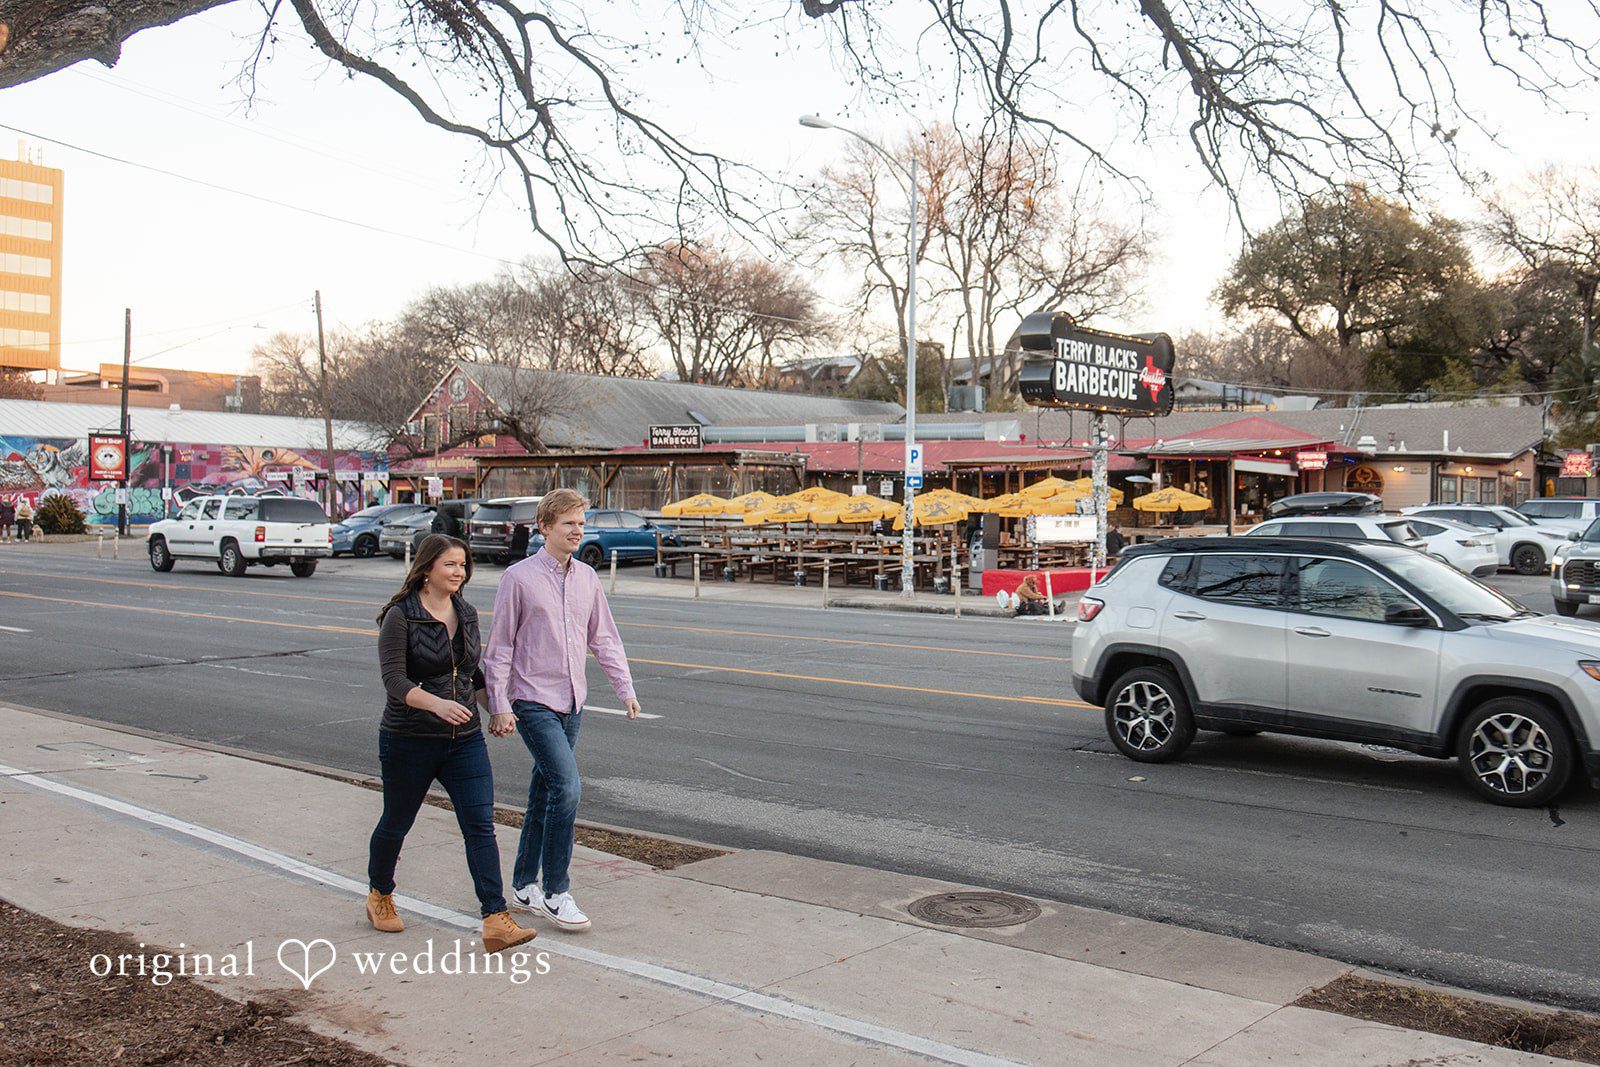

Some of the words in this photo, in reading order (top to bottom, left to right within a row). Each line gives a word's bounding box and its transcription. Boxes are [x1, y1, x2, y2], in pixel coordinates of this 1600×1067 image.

[1056, 338, 1096, 363] TERRY
[1095, 345, 1138, 370] BLACK'S
[1055, 361, 1138, 400] BARBECUE
[651, 426, 672, 438] Terry
[672, 427, 699, 437] Black's
[652, 436, 698, 445] BARBECUE
[911, 449, 919, 463] P
